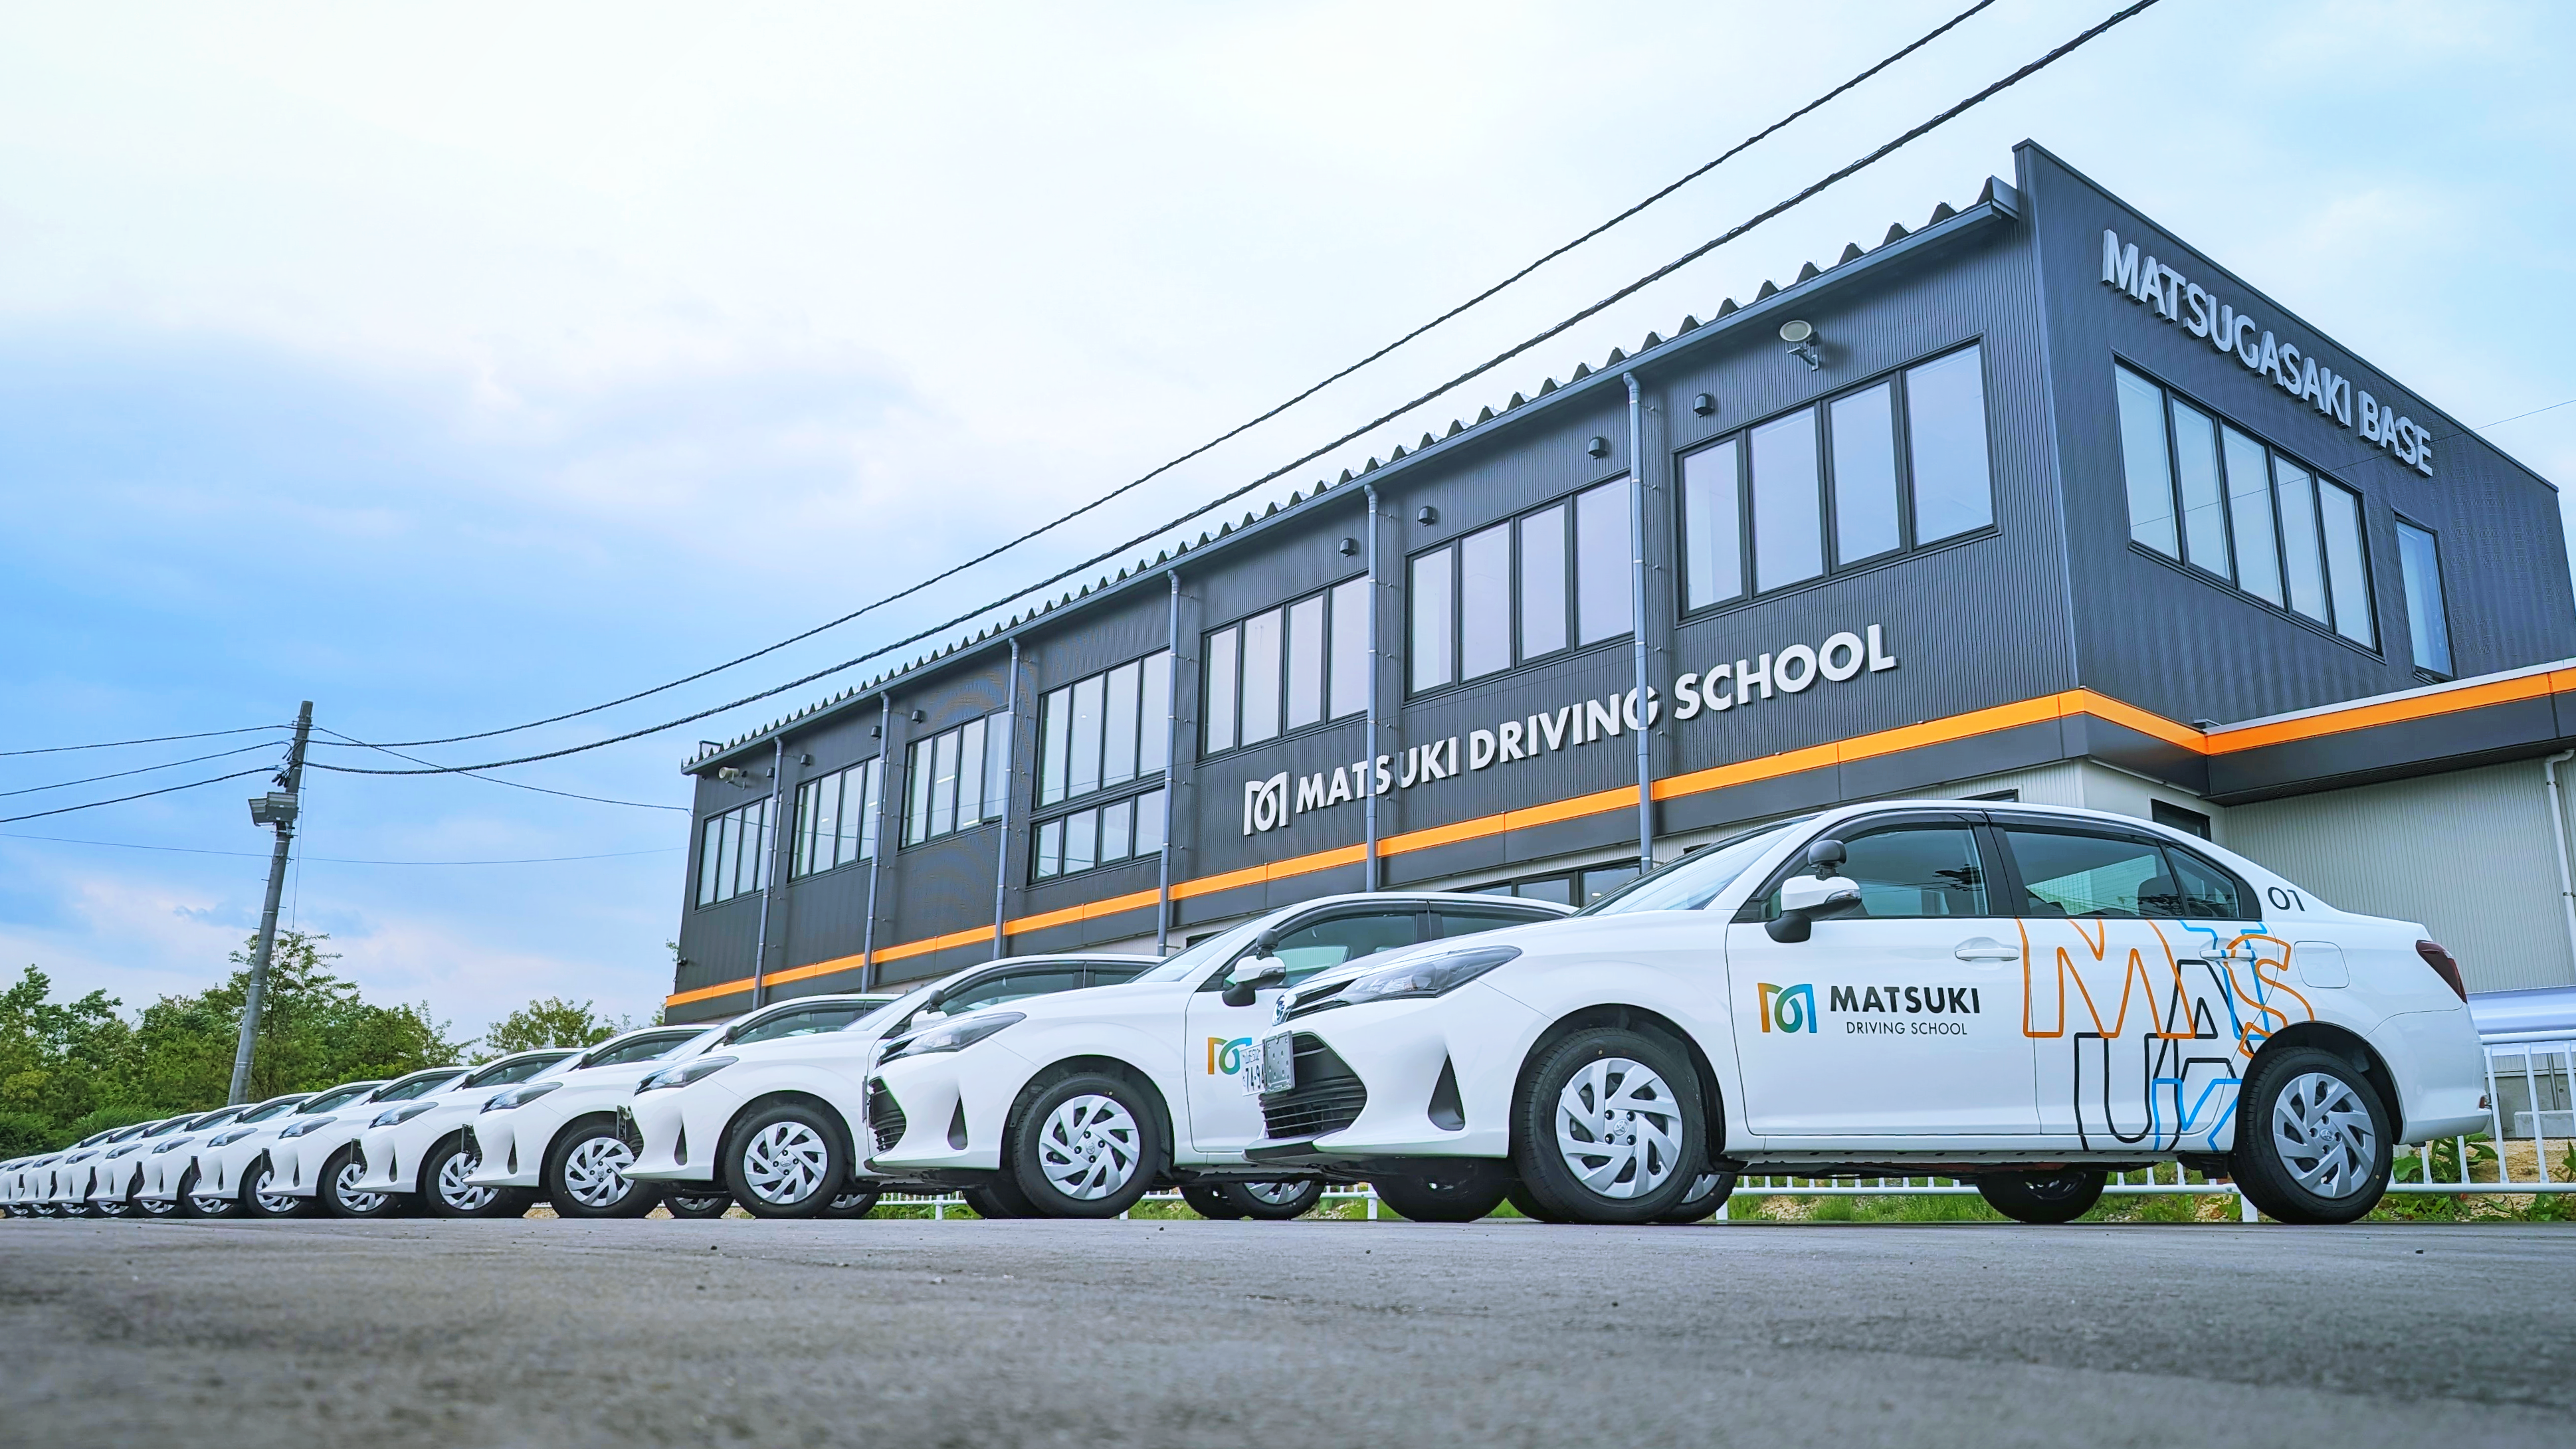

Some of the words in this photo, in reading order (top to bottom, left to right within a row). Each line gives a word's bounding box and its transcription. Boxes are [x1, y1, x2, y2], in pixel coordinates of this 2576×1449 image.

[2102, 229, 2351, 429] MATSUGASAKI
[2358, 390, 2432, 478] BASE
[1296, 736, 1459, 813] MATSUKI
[1470, 686, 1658, 770] DRIVING
[1674, 623, 1896, 720] SCHOOL
[2267, 886, 2306, 912] 01
[1830, 985, 1981, 1014] MATSUKI
[1846, 1021, 1906, 1034] DRIVING
[1911, 1022, 1968, 1035] SCHOOL
